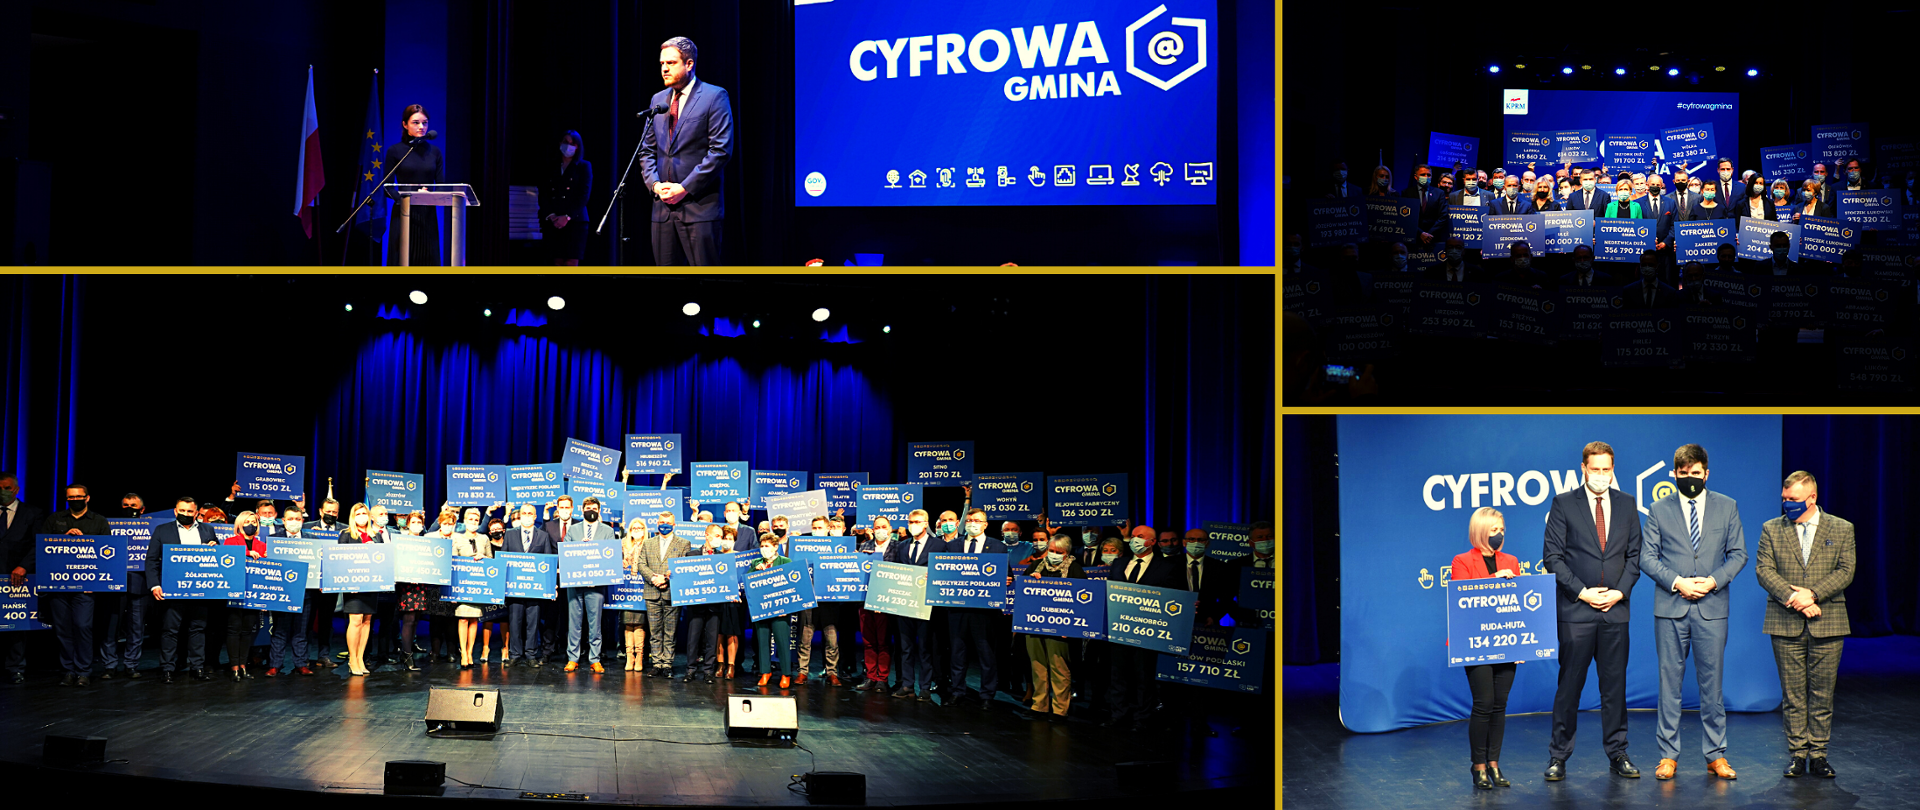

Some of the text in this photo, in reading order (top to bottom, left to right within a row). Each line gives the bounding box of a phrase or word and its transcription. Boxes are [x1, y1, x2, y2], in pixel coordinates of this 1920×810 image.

[849, 21, 1109, 81] CYFROWA
[1003, 71, 1121, 102] GMINA
[1677, 102, 1732, 111] #cyfrowagmina
[1666, 132, 1697, 141] CYFROWA
[1680, 228, 1714, 236] CYFROWA
[1804, 223, 1839, 233] CYFROWA
[1805, 243, 1818, 251] 100
[1419, 290, 1463, 300] CYFROWA
[1830, 286, 1871, 296] CYFROWA
[1422, 317, 1475, 327] 253 590 ZŁ
[1853, 313, 1870, 321] 870
[1873, 314, 1884, 322] ZŁ
[1609, 321, 1653, 329] CYFROWA
[1617, 347, 1669, 356] 175 200 ZŁ
[1843, 347, 1887, 355] CYFROWA
[1850, 373, 1867, 381] 548
[1890, 374, 1904, 382] ZŁ
[243, 461, 281, 470] CYFROWA
[1055, 485, 1098, 493] CYFROWA
[45, 546, 95, 554] CYFROWA
[564, 549, 599, 558] CYFROWA
[329, 553, 369, 561] CYFROWA
[245, 566, 282, 576] YFROWA
[675, 564, 713, 574] CYFROWA
[935, 563, 978, 571] CYFROWA
[50, 573, 113, 581] 100 000 ZŁ
[333, 575, 349, 583] 100
[351, 575, 370, 583] 000
[750, 575, 786, 589] CYFROWA
[702, 586, 717, 594] 550
[719, 585, 730, 593] ZŁ
[940, 588, 991, 597] 312 780 ZŁ
[1023, 587, 1072, 597] CYFROWA
[259, 592, 291, 602] 220 ZŁ
[1109, 593, 1160, 608] CYFROWA
[760, 594, 803, 610] 197 970 ZŁ
[1458, 594, 1519, 610] CYFROWA
[1139, 606, 1161, 614] GMINA
[1496, 605, 1521, 613] GMINA
[4, 612, 26, 620] 400
[1026, 614, 1088, 627] 100 000 ZŁ
[1120, 614, 1168, 626] KRASNOBRÓD
[1481, 621, 1526, 631] RUDA-HUTA
[1112, 622, 1172, 640] 210 660 ZŁ
[1469, 632, 1538, 648] 134 220 ZŁ
[1177, 662, 1240, 679] 157 710 ZŁ
